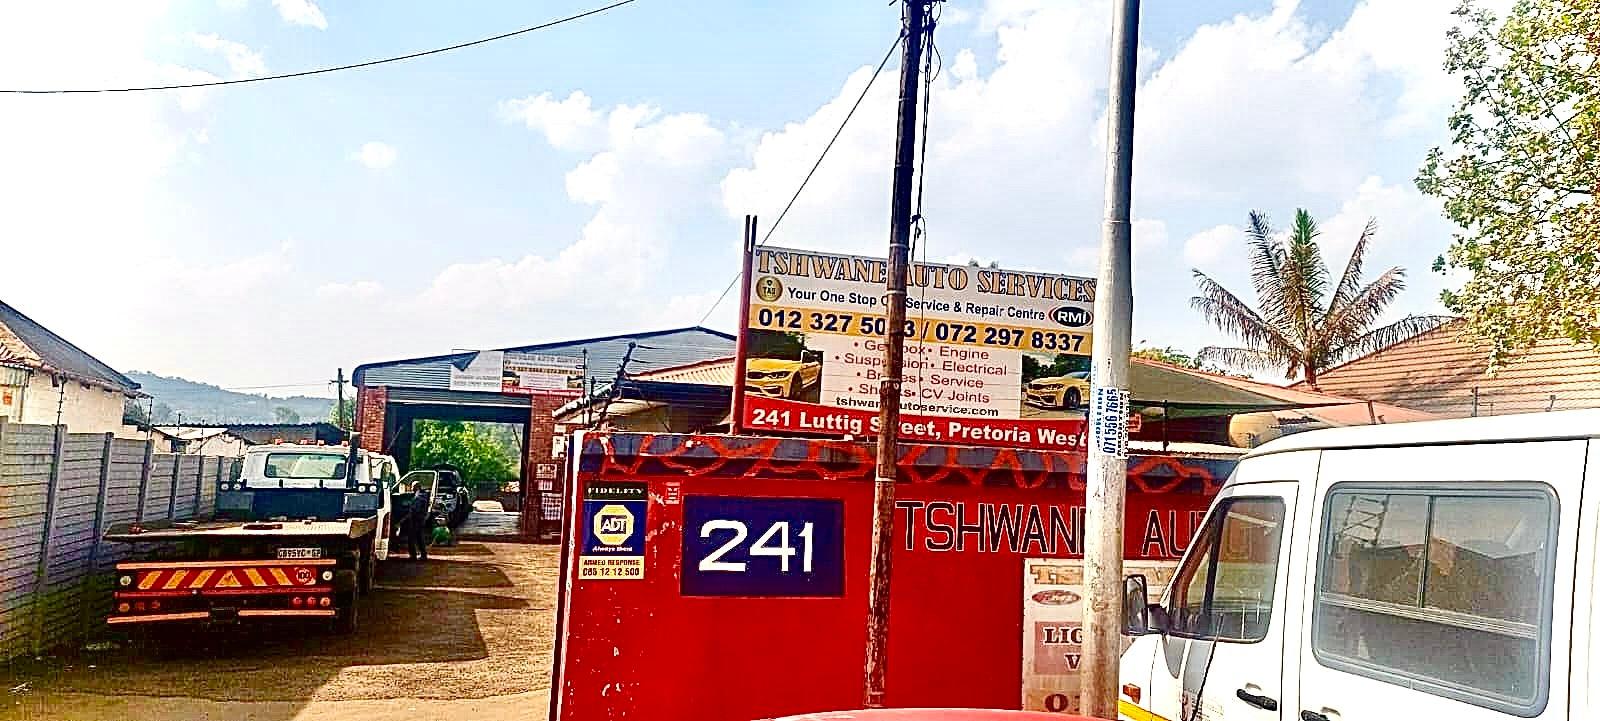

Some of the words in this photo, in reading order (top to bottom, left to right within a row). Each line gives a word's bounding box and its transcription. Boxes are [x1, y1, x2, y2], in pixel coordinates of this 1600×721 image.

[755, 249, 887, 284] TSHWANE
[977, 270, 1097, 303] SERVICES
[788, 287, 816, 301] Your
[820, 290, 845, 303] One
[849, 294, 877, 307] Stop
[905, 298, 950, 312] Service
[953, 302, 962, 313] &
[966, 303, 1004, 318] Repair
[1008, 306, 1045, 320] Centre
[1056, 310, 1088, 324] RMI
[759, 309, 802, 329] 012
[810, 313, 852, 333] 327
[860, 317, 915, 338] 503
[922, 322, 930, 339] /
[935, 323, 977, 343] 072
[984, 327, 1025, 347] 297
[1031, 331, 1084, 352] 8337
[939, 346, 989, 361] Engine
[943, 360, 1008, 376] Electrical
[866, 369, 917, 383] Bres
[930, 375, 984, 388] Service
[921, 388, 944, 399] CV
[947, 390, 990, 404] Joints
[1105, 389, 1118, 413] 7665
[752, 408, 790, 426] 241
[799, 411, 862, 434] Luttig
[869, 416, 941, 440] Seet,
[948, 422, 1031, 444] Pretoria
[1037, 428, 1087, 447] West
[1104, 416, 1118, 435] 556
[1102, 437, 1116, 454] 071
[587, 487, 644, 495] FIDELITY
[600, 517, 628, 532] ADT
[895, 500, 1085, 555] TSHWAN
[699, 519, 813, 573] 241
